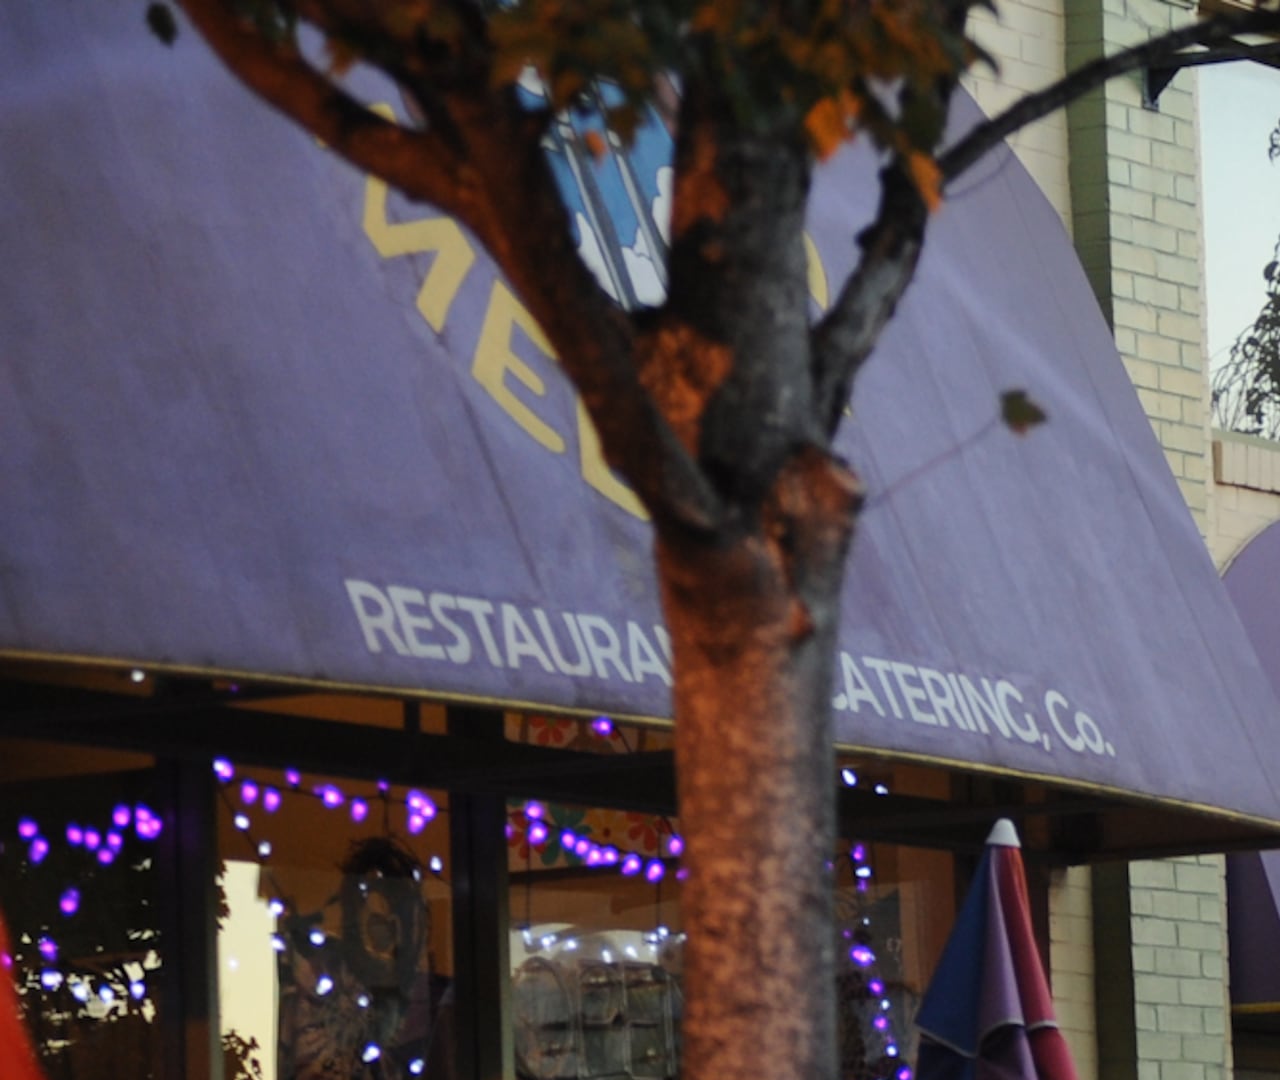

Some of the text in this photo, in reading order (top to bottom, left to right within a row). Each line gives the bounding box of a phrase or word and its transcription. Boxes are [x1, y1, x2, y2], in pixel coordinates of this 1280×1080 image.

[344, 578, 1116, 757] RESTAURA ATERING, Co.
